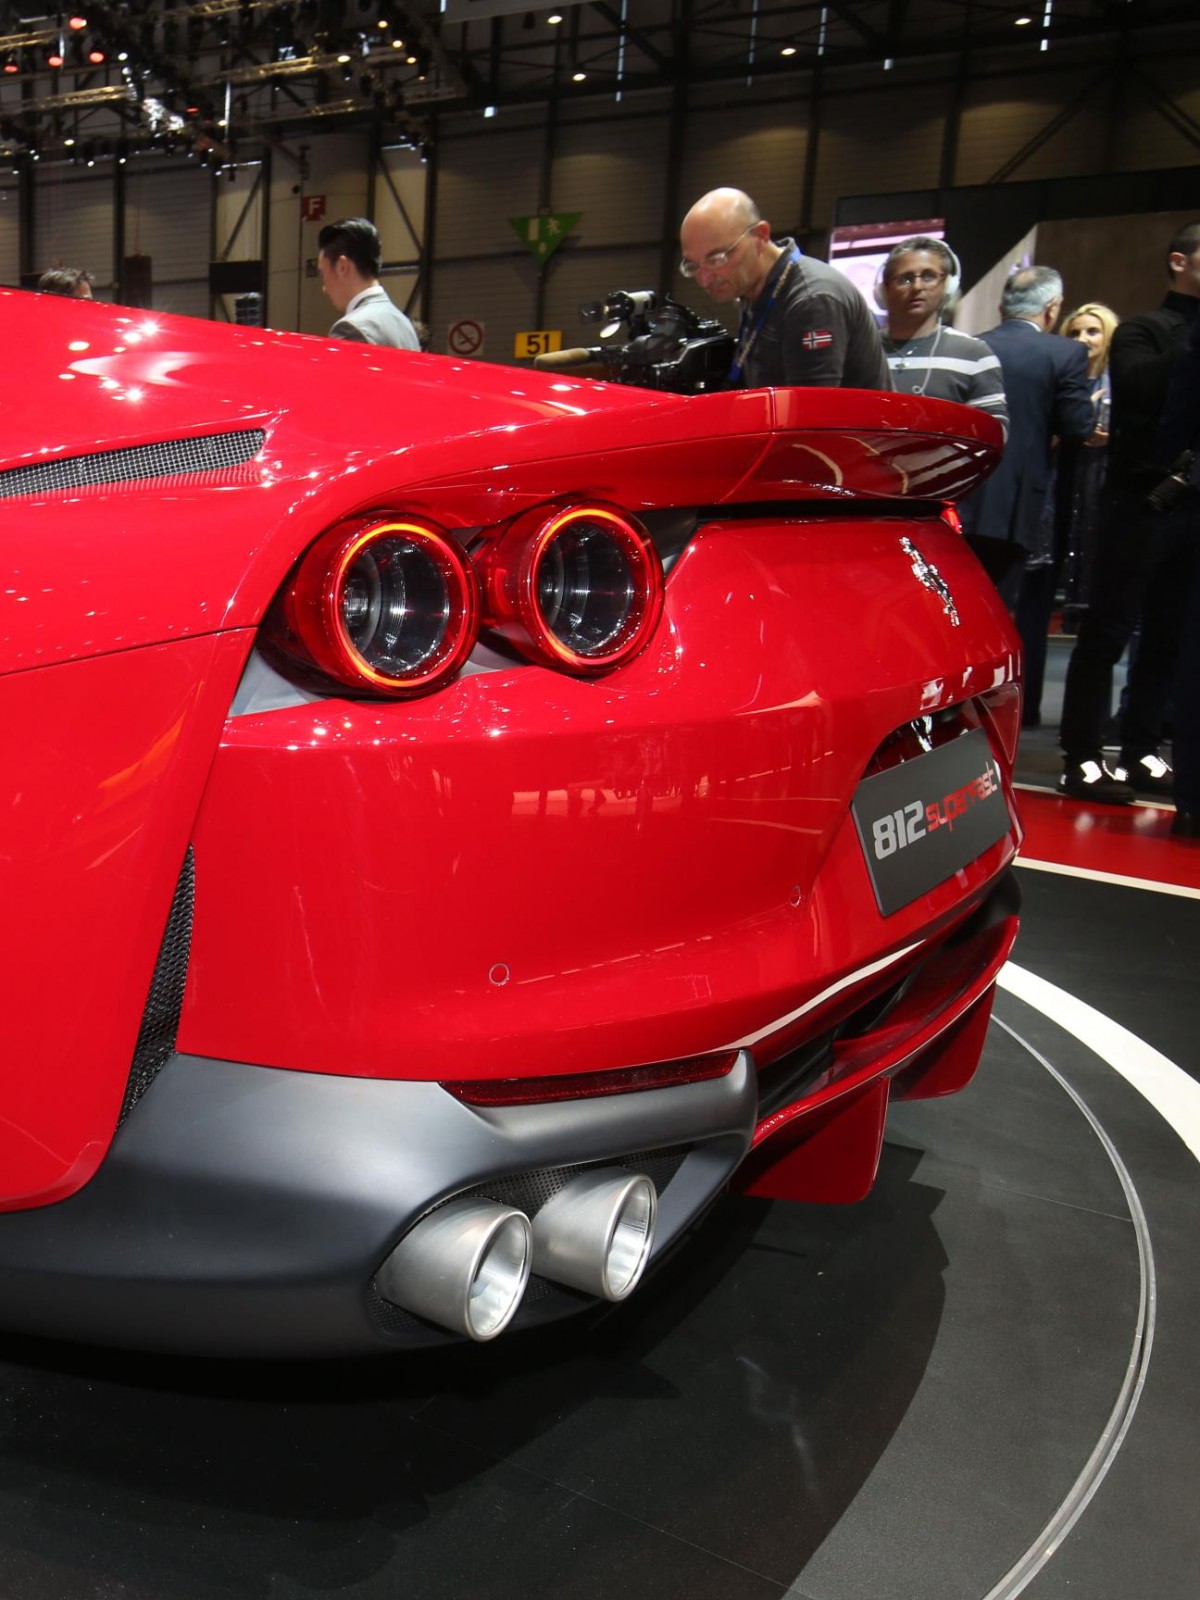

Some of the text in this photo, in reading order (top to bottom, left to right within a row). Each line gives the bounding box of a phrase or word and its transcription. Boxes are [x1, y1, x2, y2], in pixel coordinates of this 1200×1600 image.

[309, 198, 321, 215] F
[527, 334, 550, 355] 51
[872, 800, 927, 860] 812
